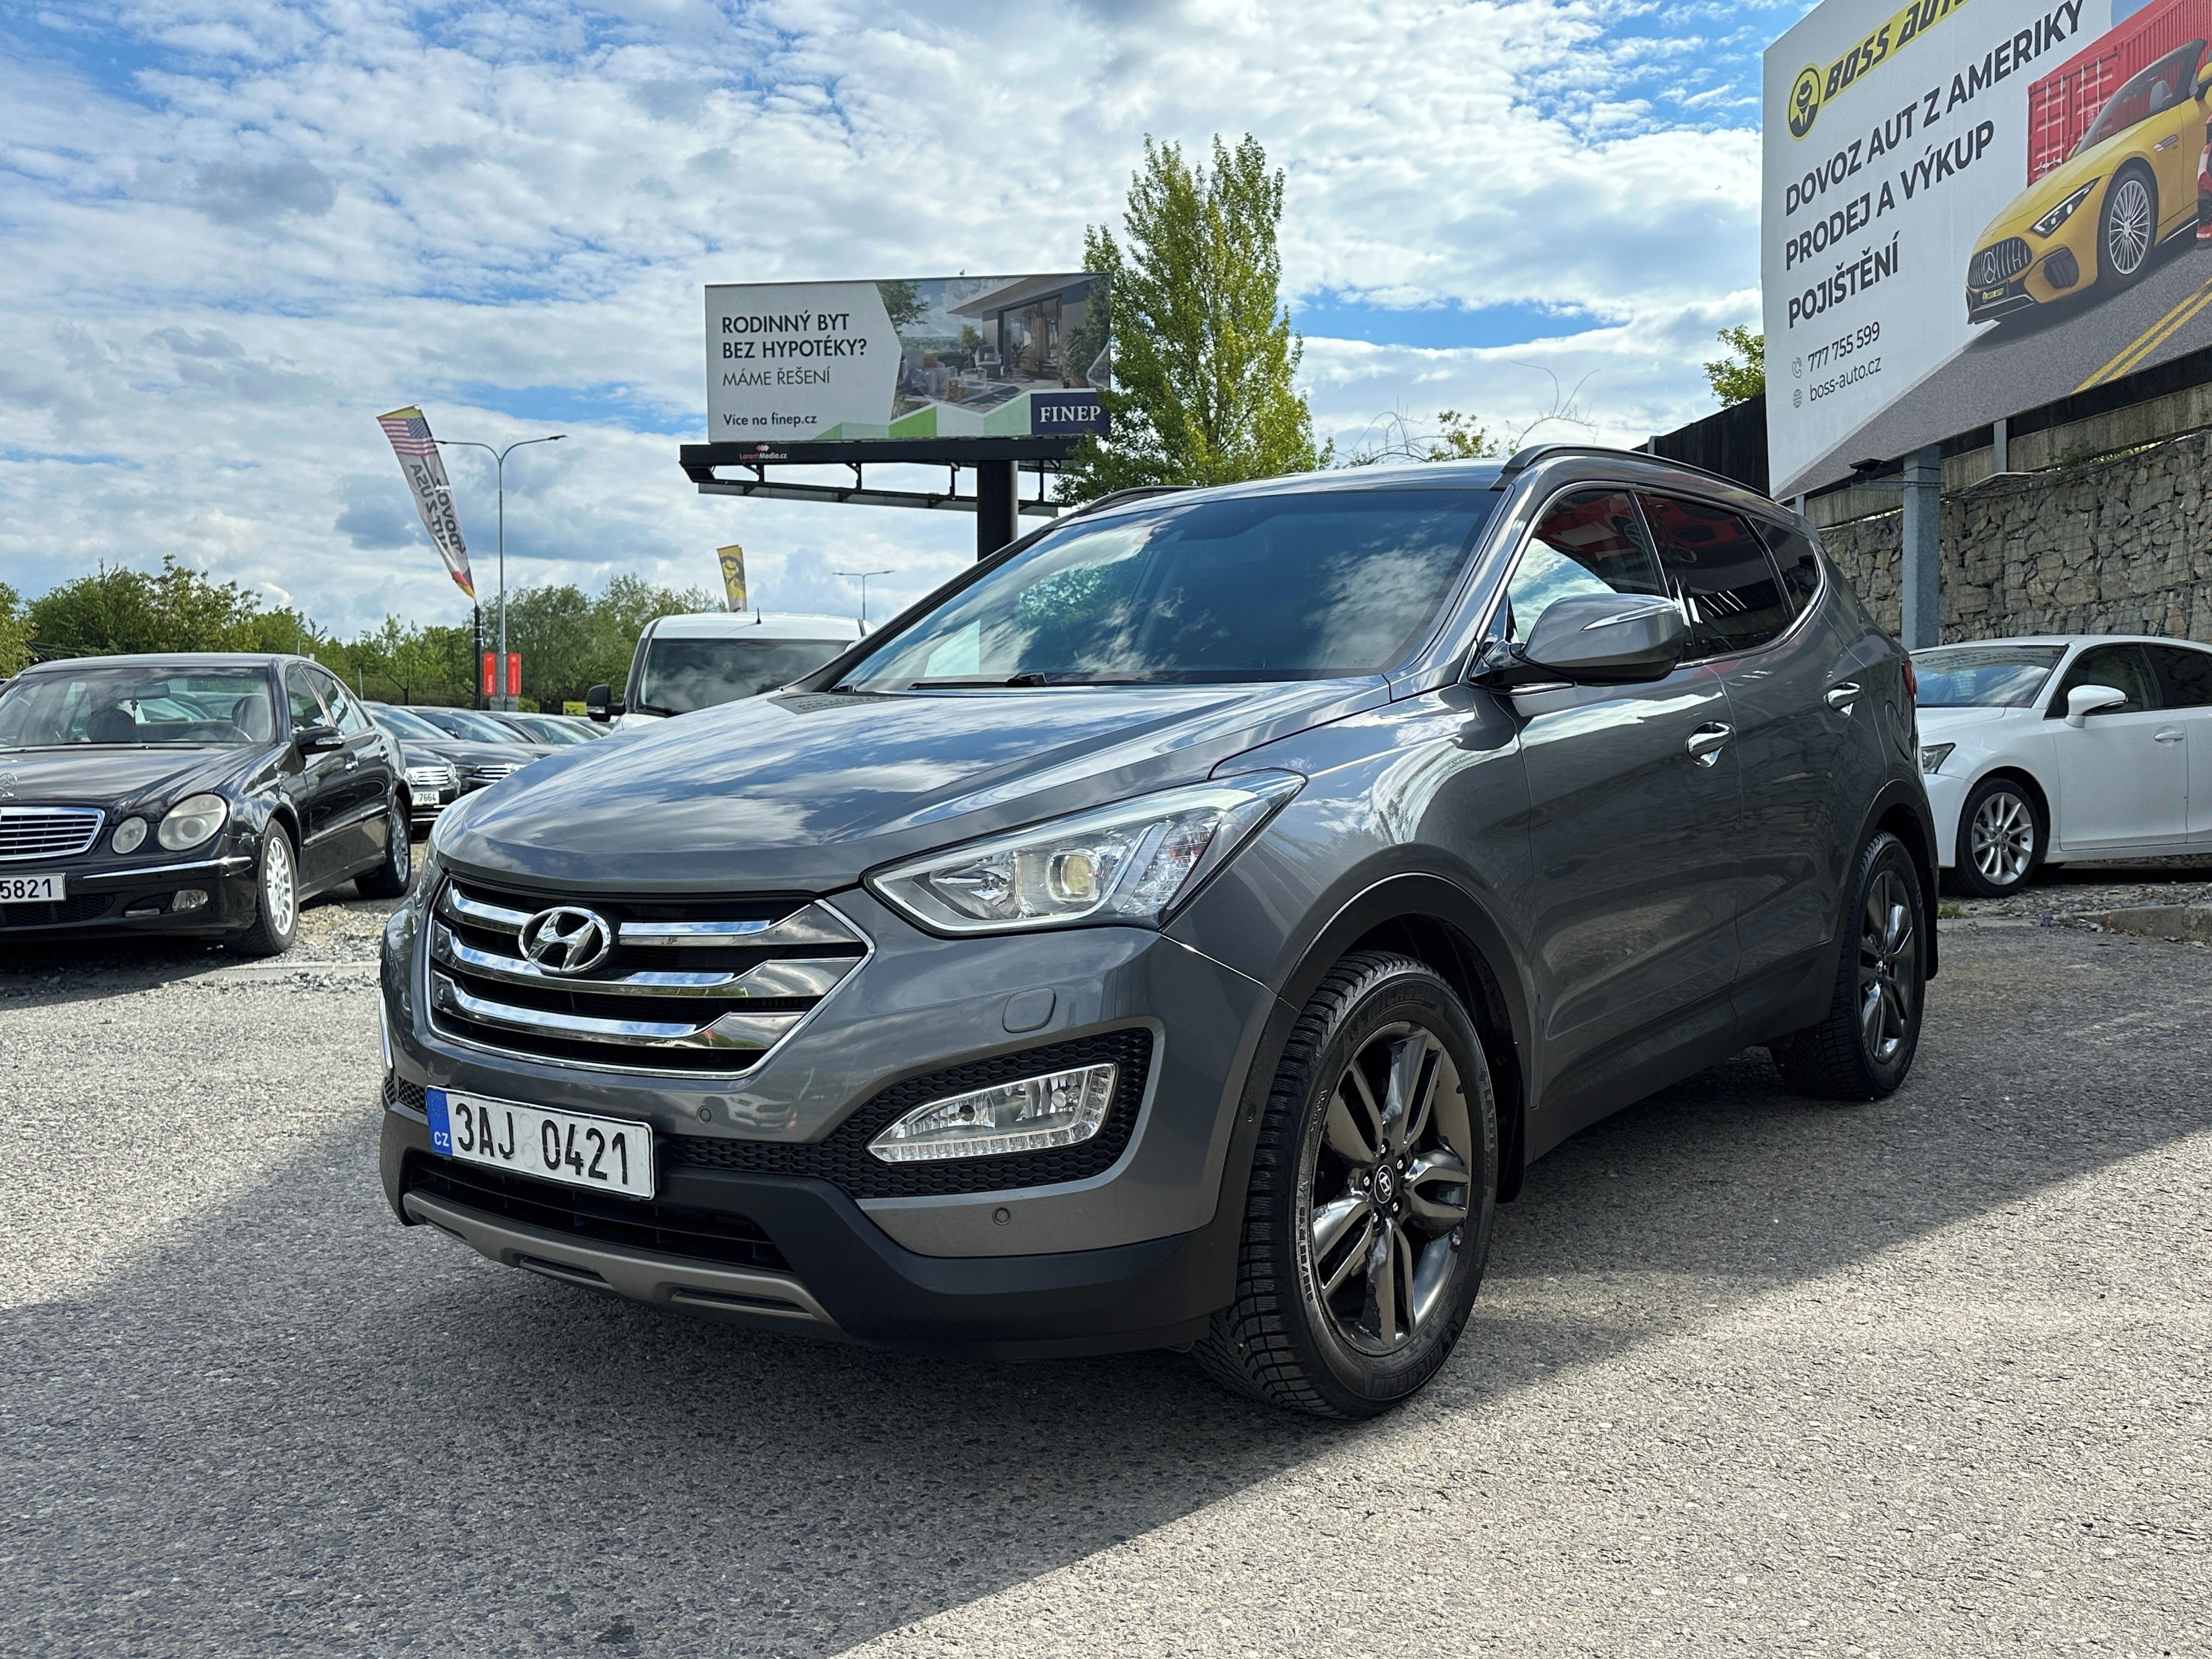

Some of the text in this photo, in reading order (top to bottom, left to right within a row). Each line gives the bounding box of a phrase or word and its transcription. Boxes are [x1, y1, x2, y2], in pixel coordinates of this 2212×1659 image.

[1823, 0, 1964, 102] BOSS AU
[1786, 0, 2083, 217] DOVOZ AUT Z AMERIKY
[1786, 120, 1994, 271] PRODEJ A VÝKUP
[1788, 230, 1900, 329] POJIŠTĚNÍ
[722, 310, 849, 334] RODINNÝ BYT
[723, 335, 867, 359] BEZ HYPOTÉKY?
[1808, 321, 1880, 372] 777 755 599
[723, 365, 831, 386] MÁME ŘEŠENÍ
[1810, 357, 1882, 402] boss-auto.cz
[723, 411, 817, 428] Více na finep.cz
[1040, 405, 1102, 422] FINEP
[0, 878, 52, 900] 5821
[434, 1131, 449, 1148] CZ
[455, 1103, 628, 1186] 3AJ 0421
